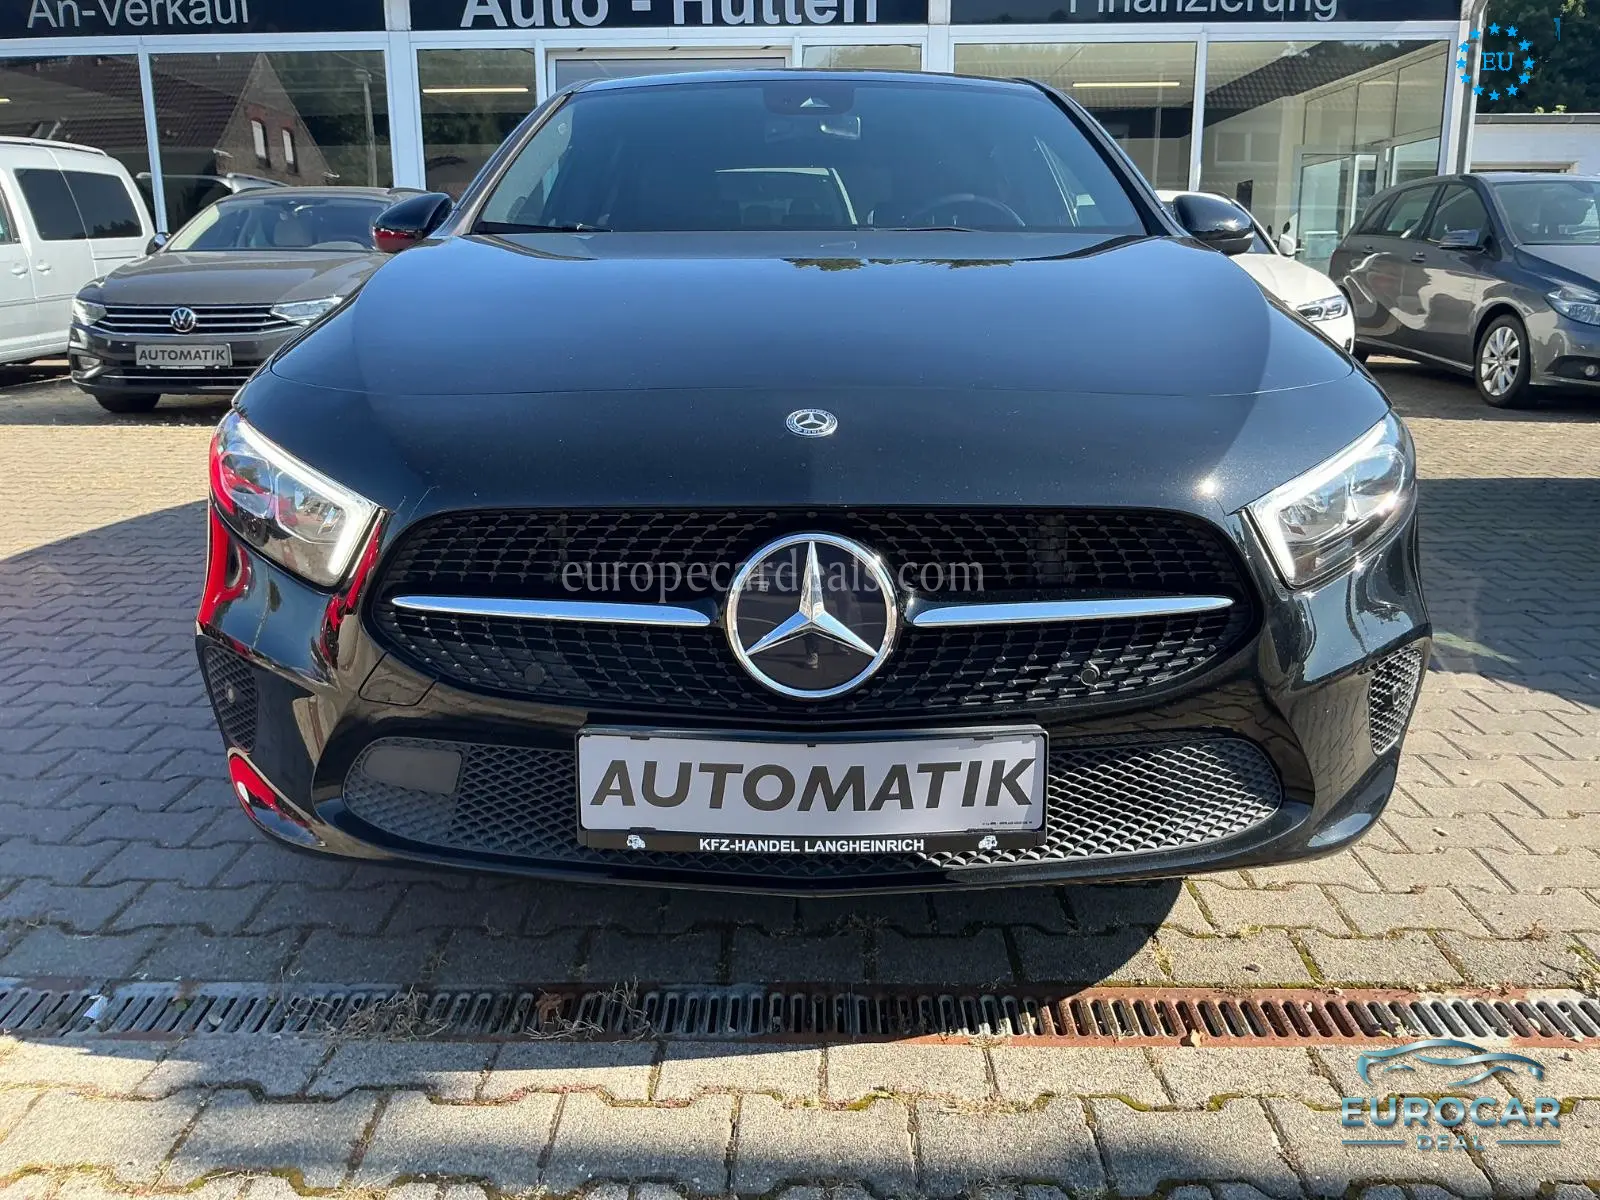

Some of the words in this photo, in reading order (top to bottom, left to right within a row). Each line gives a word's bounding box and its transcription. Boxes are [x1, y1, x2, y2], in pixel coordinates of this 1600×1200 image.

[460, 0, 608, 27] Auto
[139, 349, 225, 360] AUTOMATIK
[590, 758, 1037, 812] AUTOMATIK
[699, 838, 800, 852] KFZ-HANDEL
[804, 838, 925, 853] LANGHEINRICH
